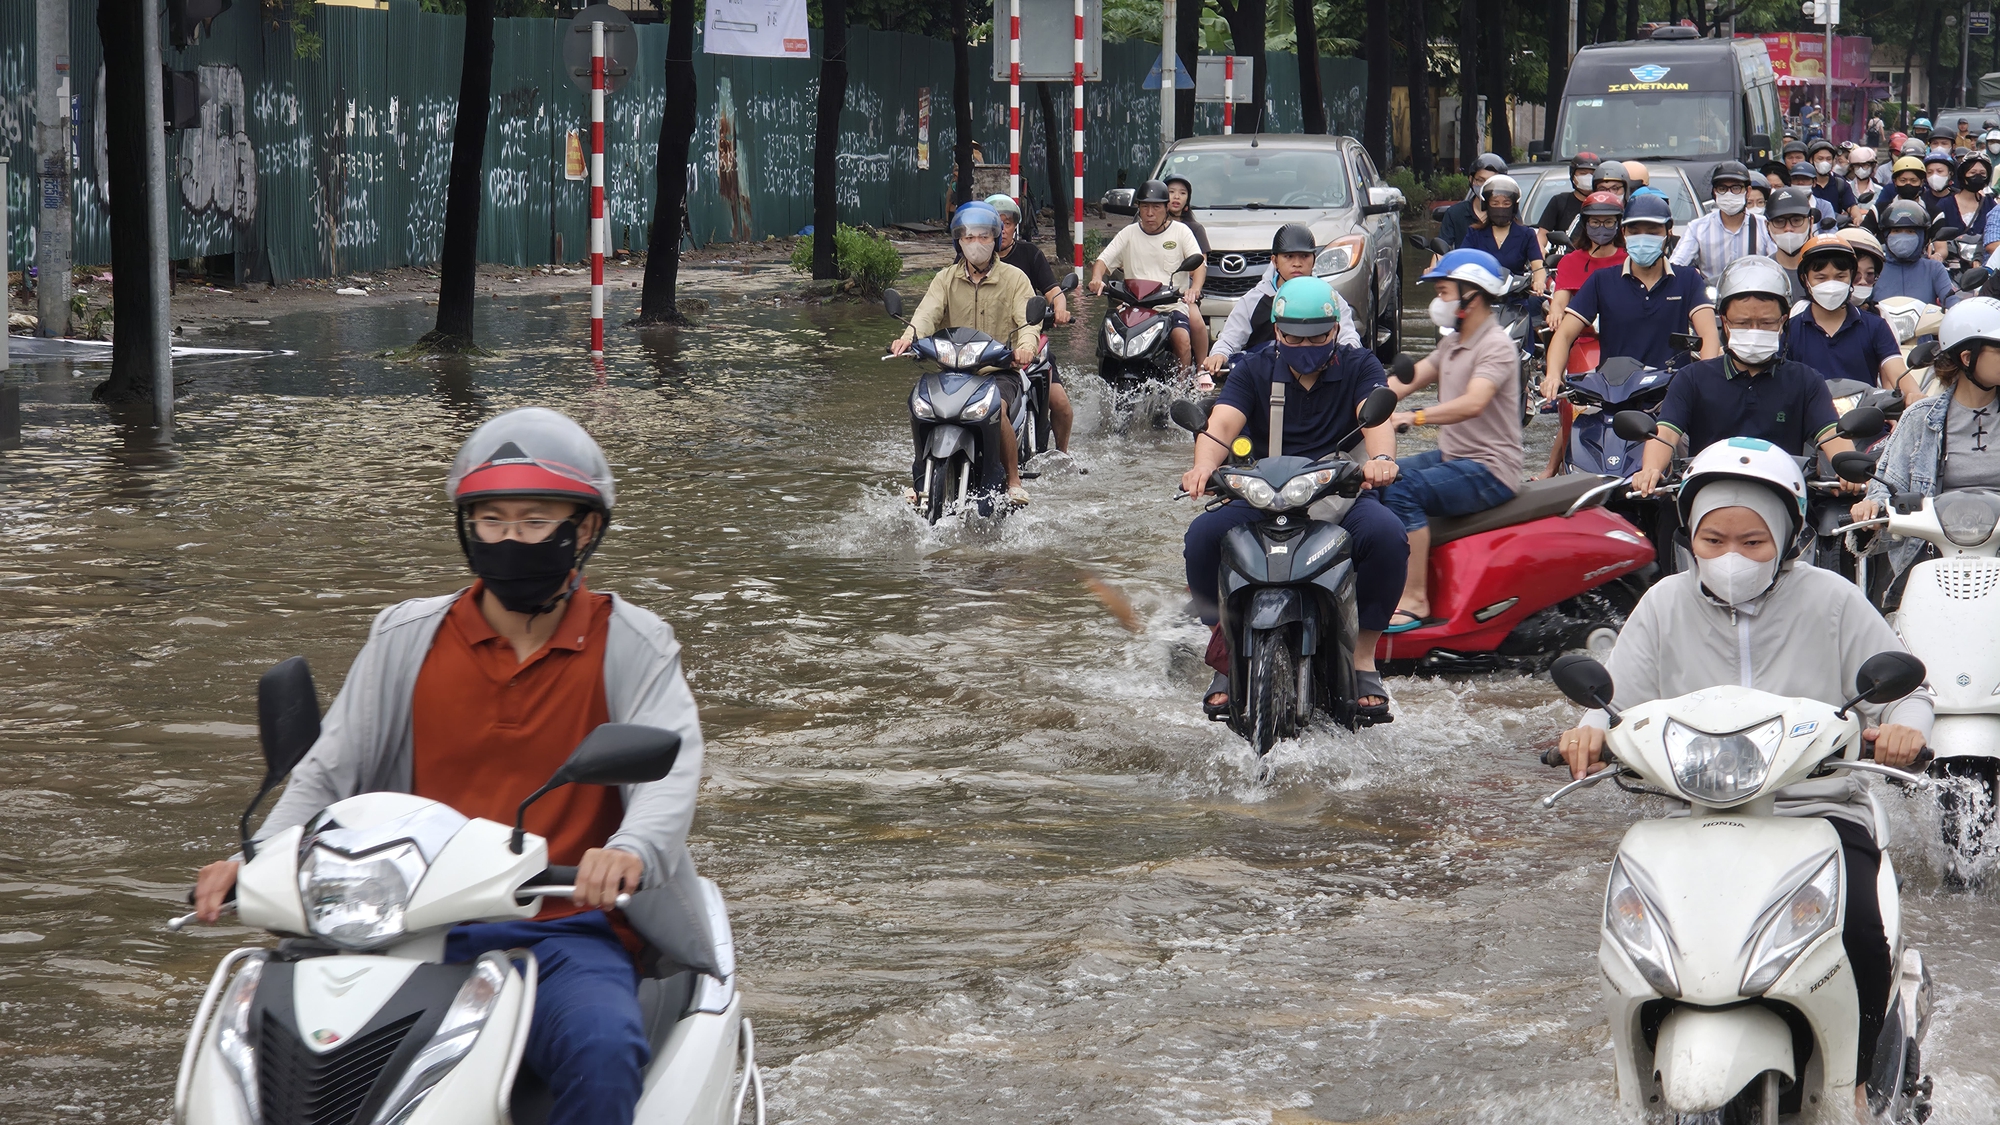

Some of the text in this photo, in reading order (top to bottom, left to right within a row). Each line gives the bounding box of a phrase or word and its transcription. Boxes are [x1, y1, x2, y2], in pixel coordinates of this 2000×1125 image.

[1306, 538, 1336, 566] JUPITER
[1701, 820, 1746, 829] HONDA
[1809, 964, 1842, 994] HONDA
